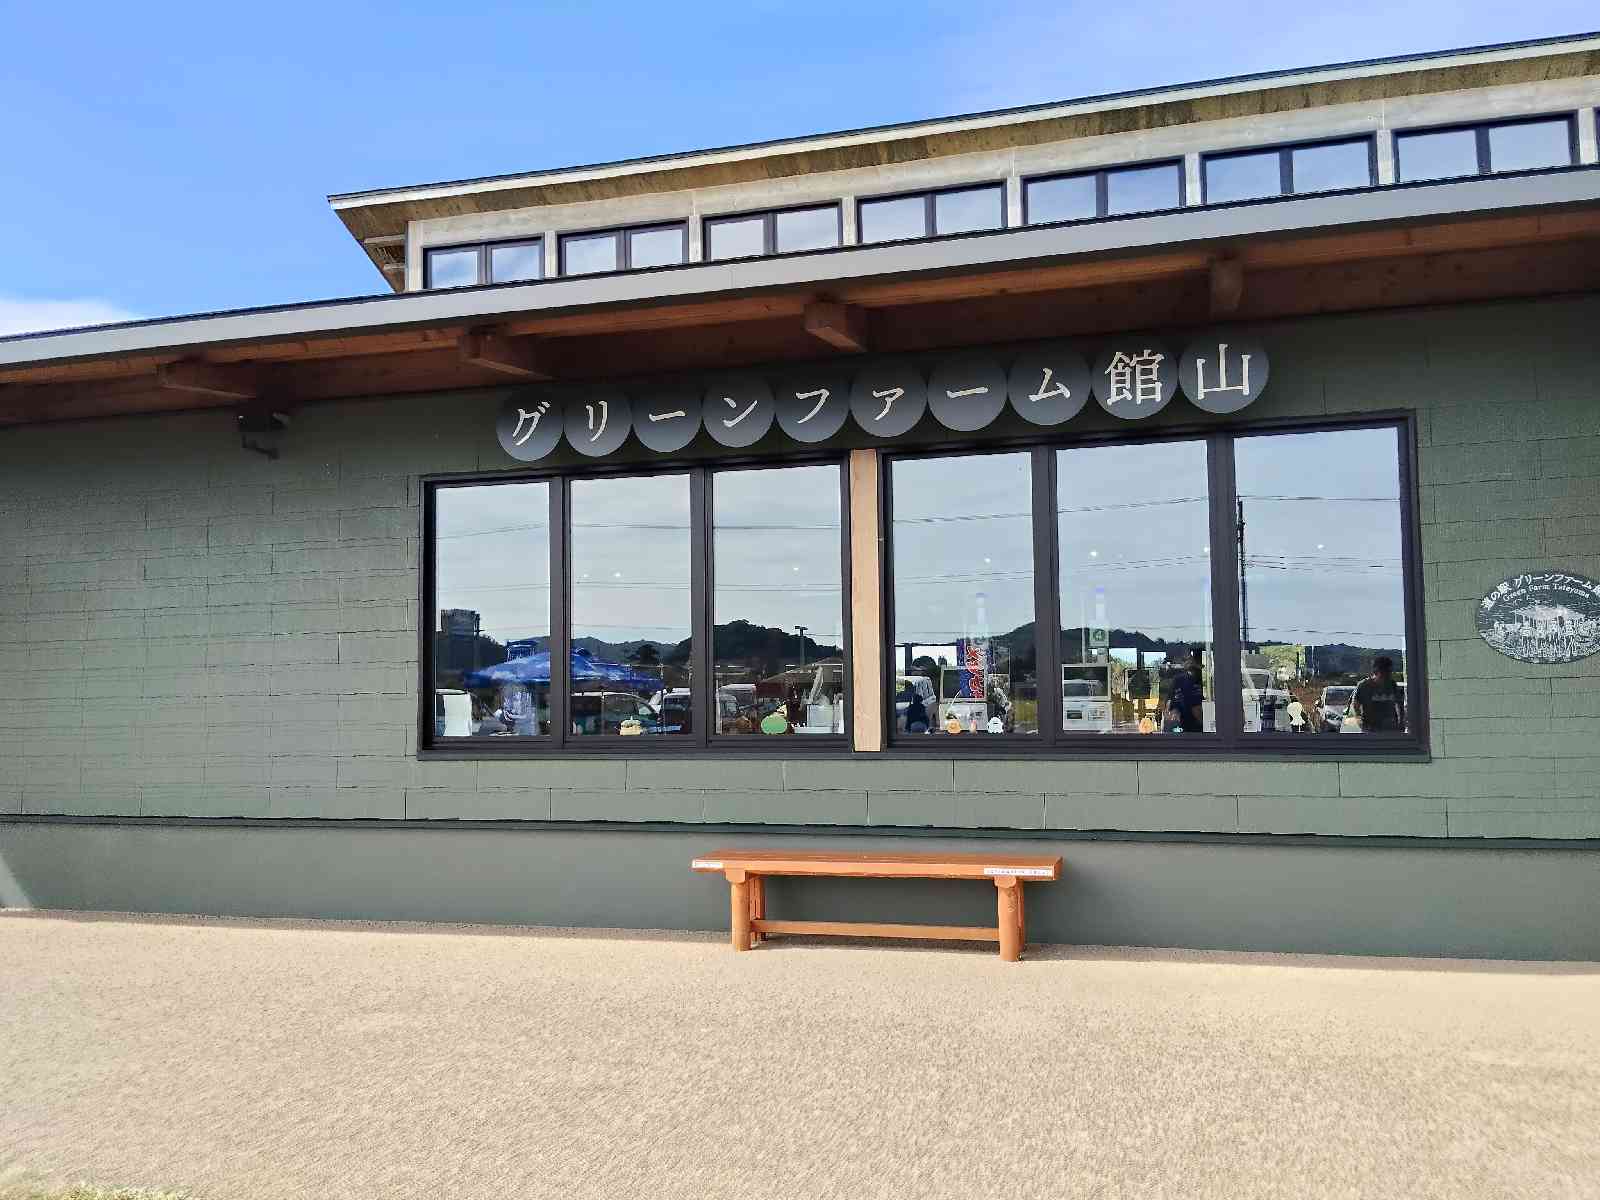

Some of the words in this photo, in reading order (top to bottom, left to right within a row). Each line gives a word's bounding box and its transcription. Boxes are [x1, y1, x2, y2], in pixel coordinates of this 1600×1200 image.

[512, 343, 1252, 446] グリーンファーム館山
